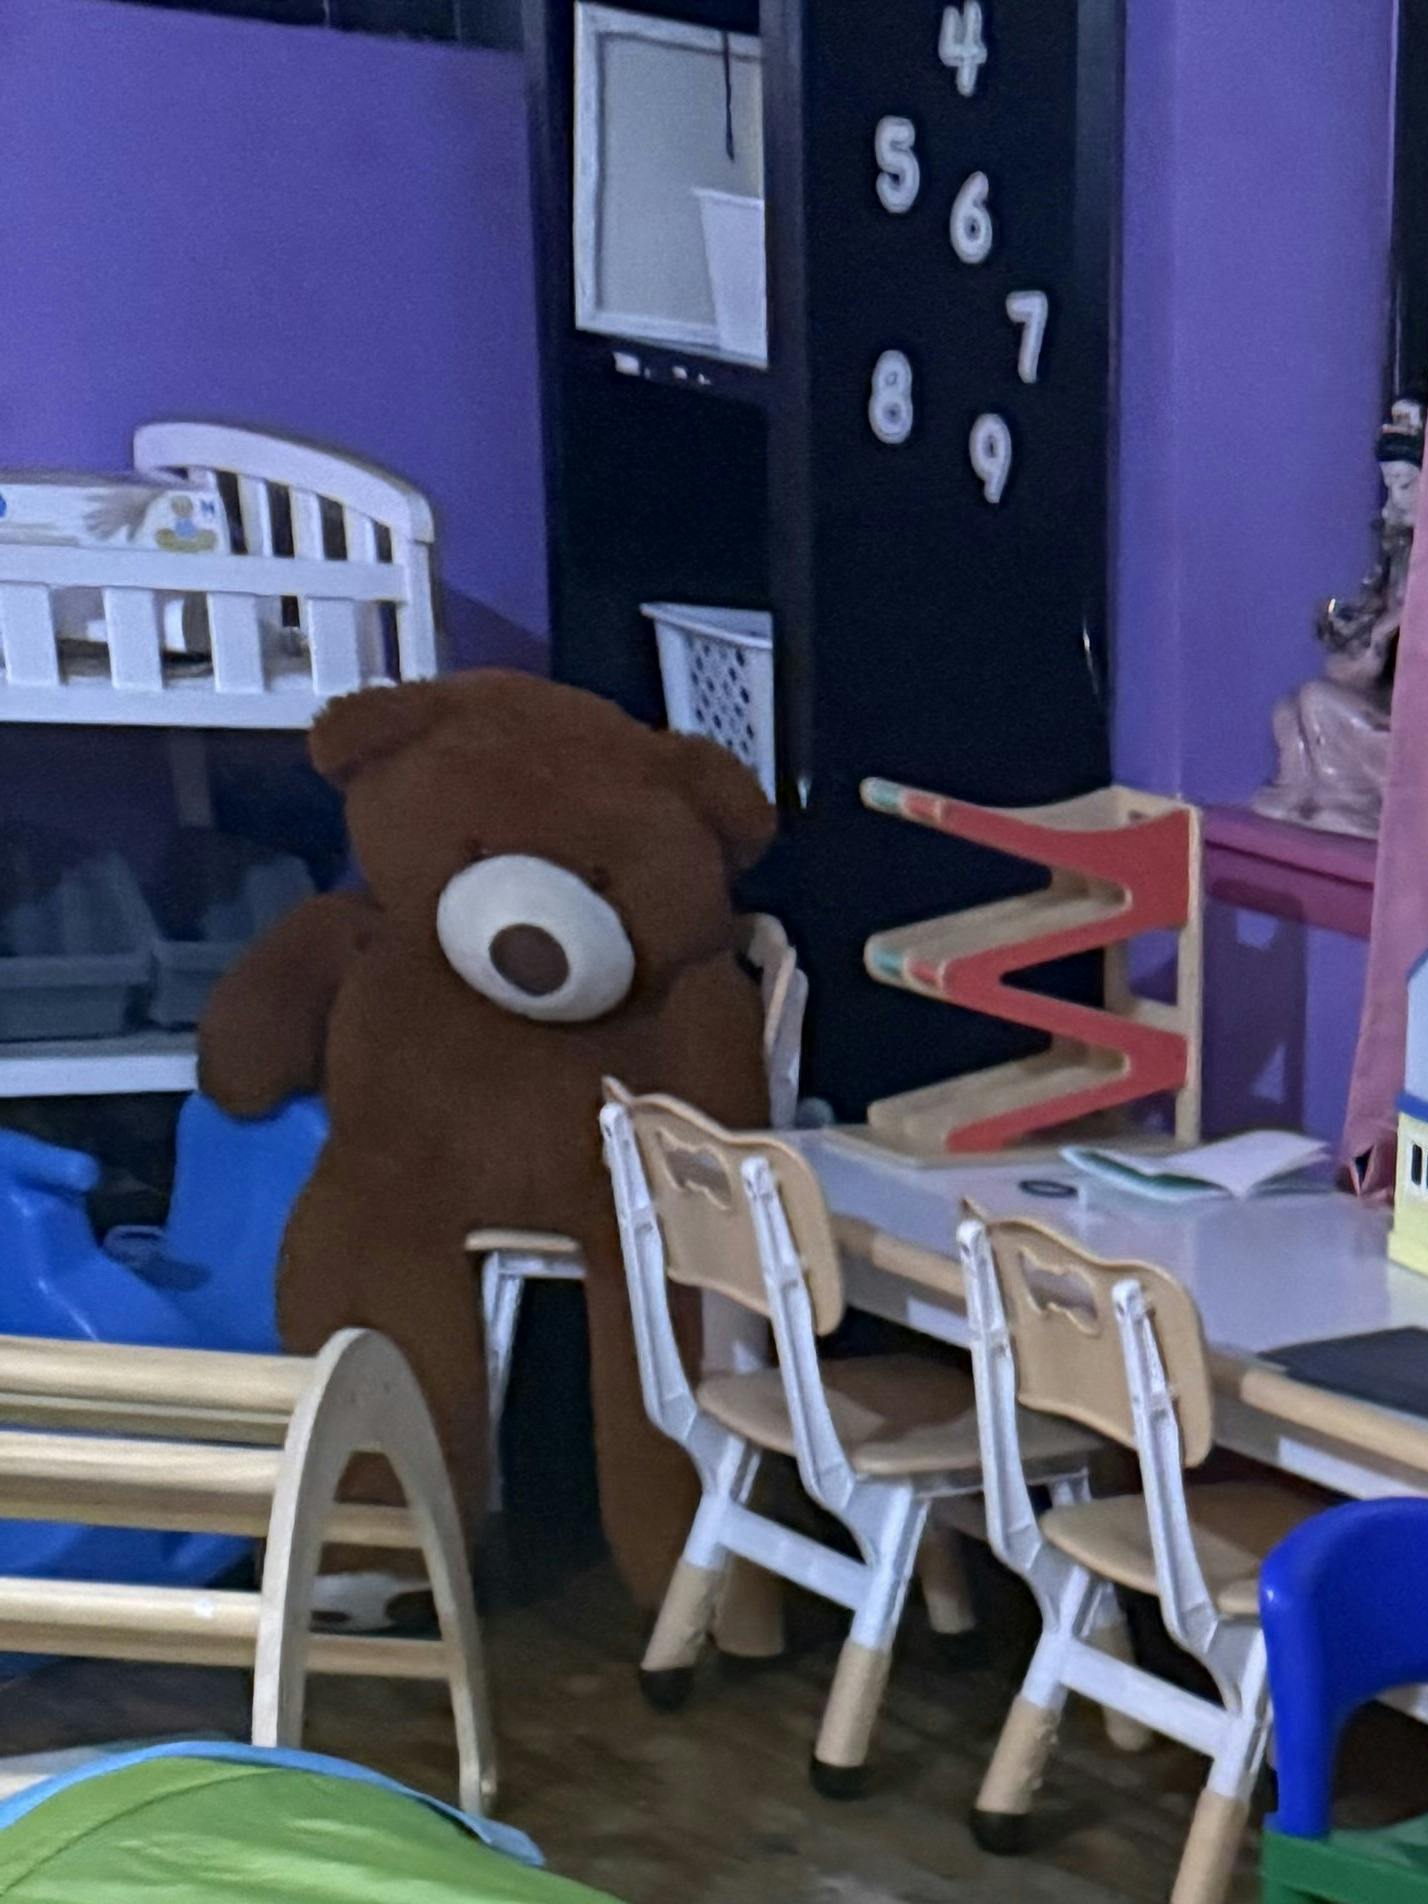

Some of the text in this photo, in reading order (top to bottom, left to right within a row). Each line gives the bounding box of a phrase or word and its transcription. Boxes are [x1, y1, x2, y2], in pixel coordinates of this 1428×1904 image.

[940, 0, 987, 95] 4
[874, 117, 919, 210] 5
[950, 172, 992, 262] 6
[1006, 291, 1047, 382] 7
[869, 350, 912, 442] 8
[969, 413, 1011, 502] 9
